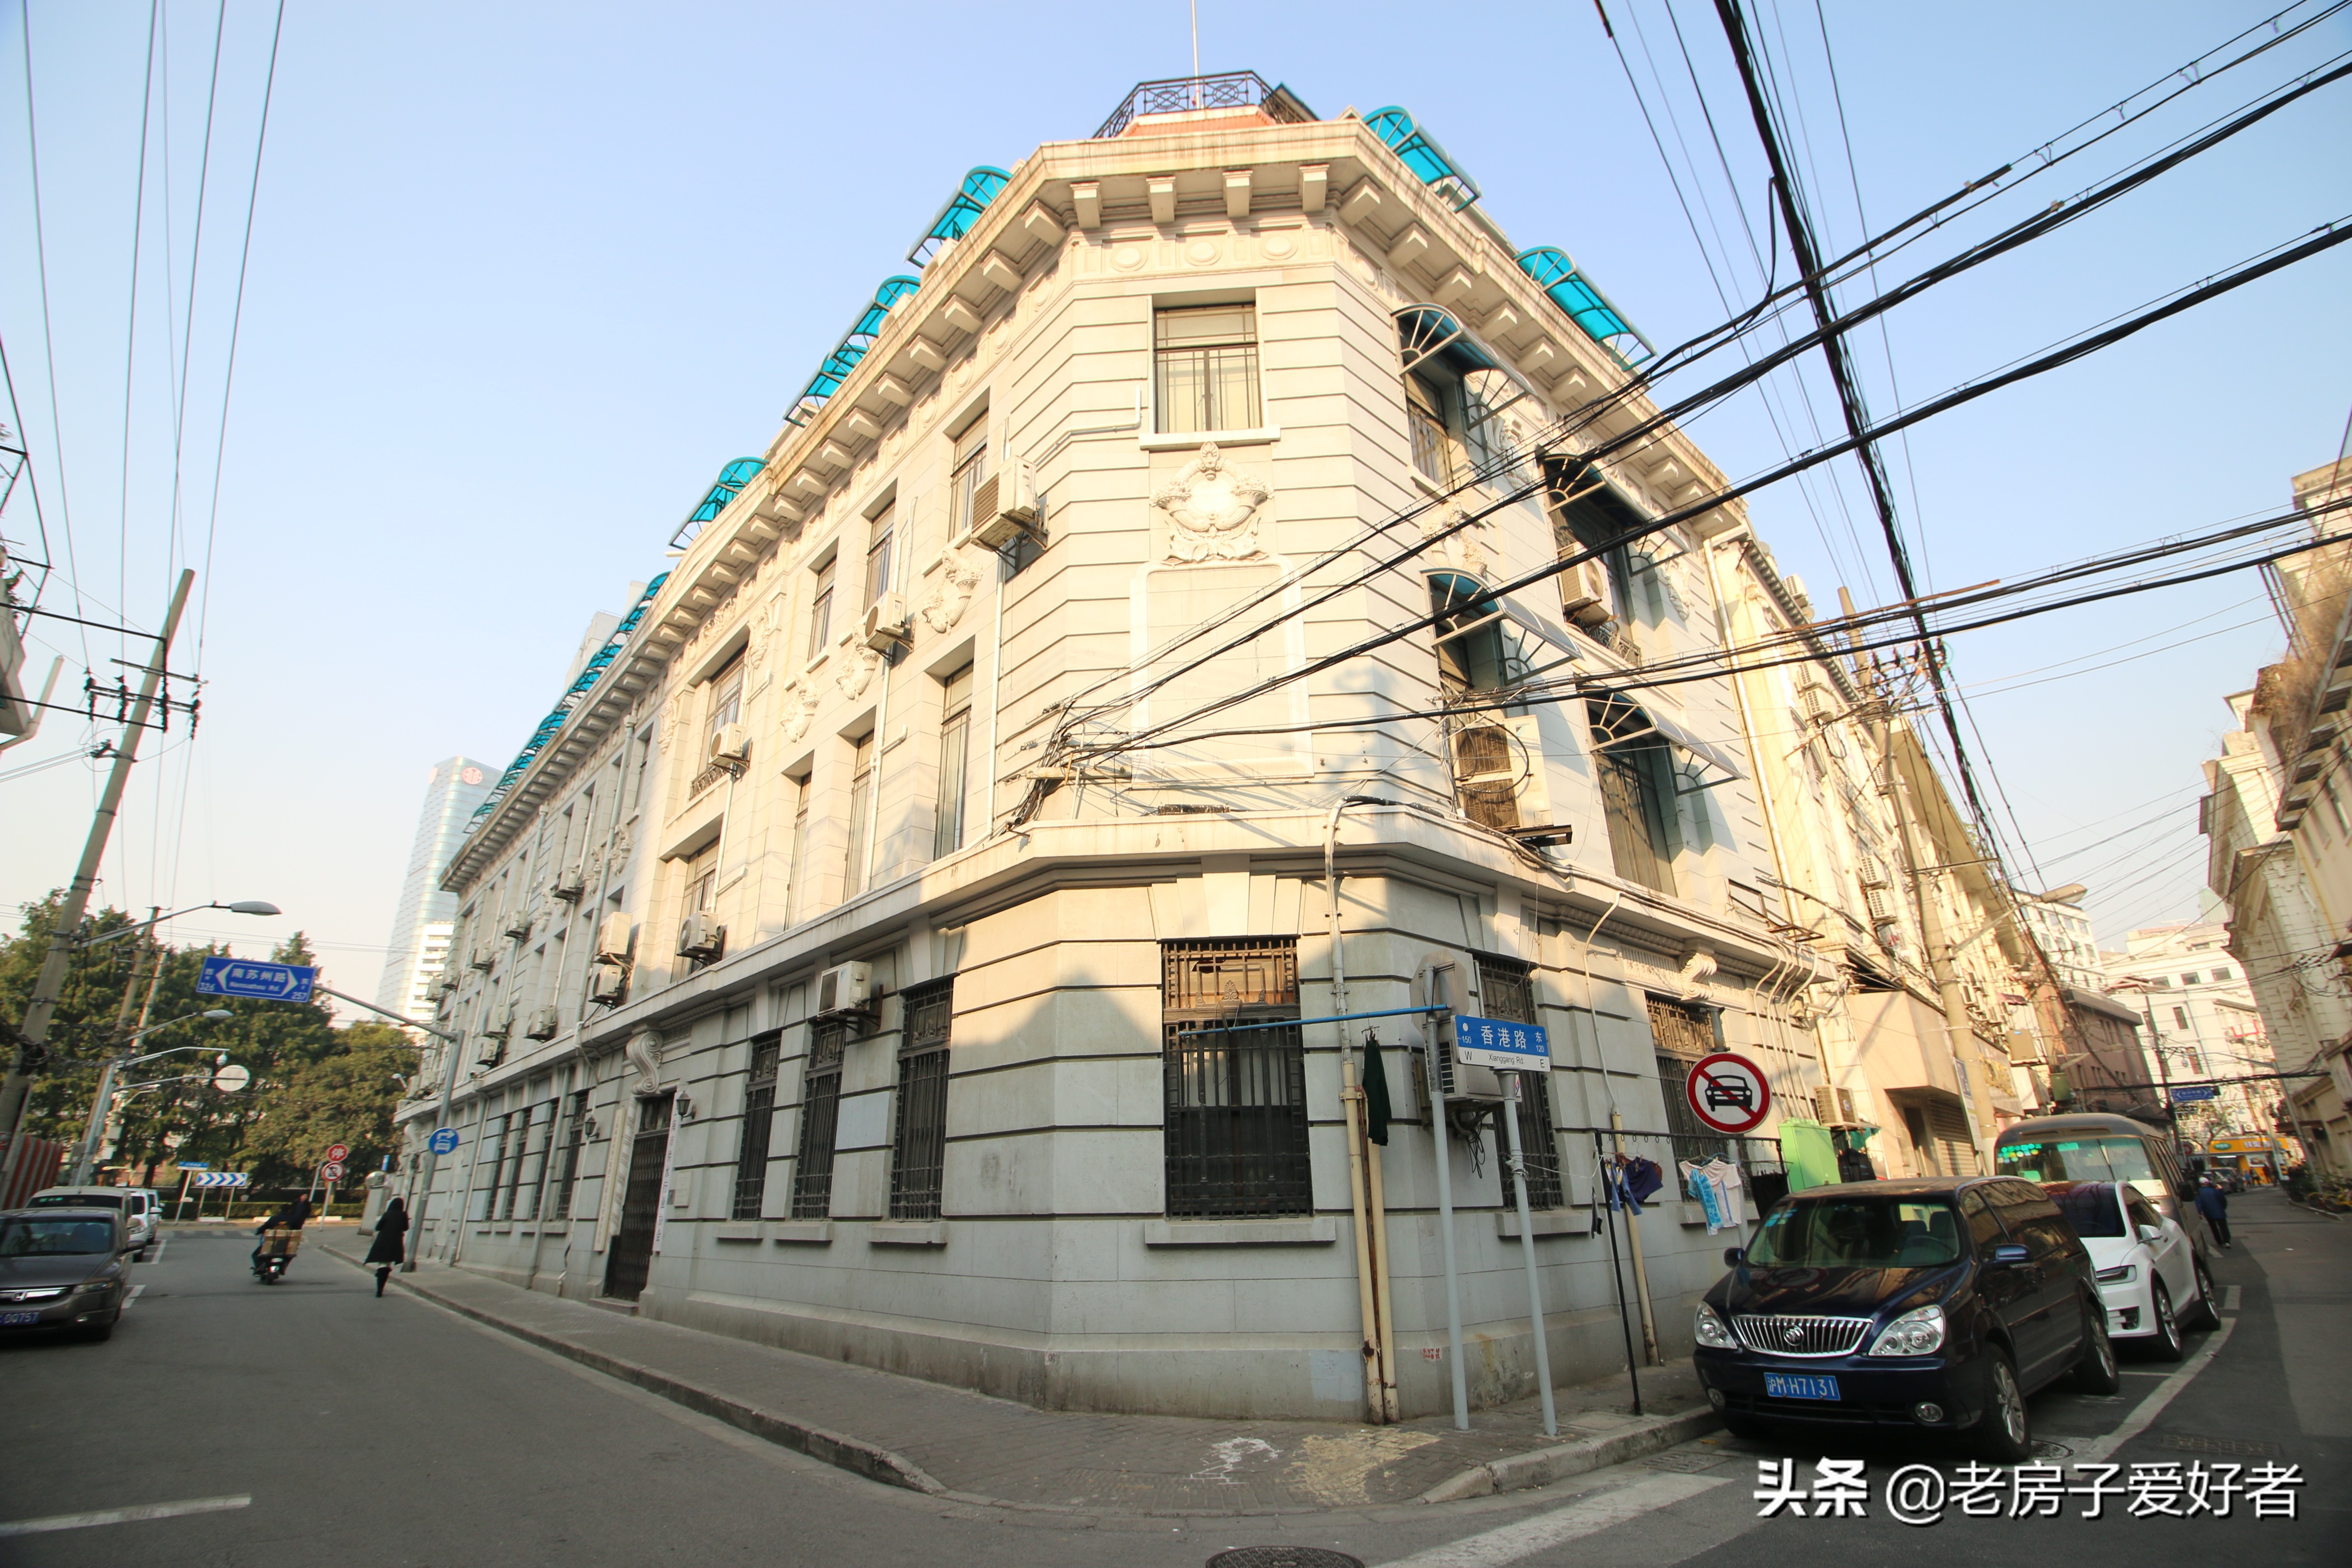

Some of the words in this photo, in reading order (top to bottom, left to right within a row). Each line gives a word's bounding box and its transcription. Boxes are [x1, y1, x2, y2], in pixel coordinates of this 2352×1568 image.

[231, 968, 287, 983] 南苏州路
[291, 992, 308, 1000] 257
[1462, 1035, 1472, 1044] 150
[1481, 1026, 1526, 1049] 香港路
[1535, 1032, 1542, 1042] 东
[1465, 1051, 1472, 1060] W
[1488, 1054, 1514, 1065] Xianggang
[1540, 1059, 1545, 1068] E
[331, 1147, 344, 1159] 停
